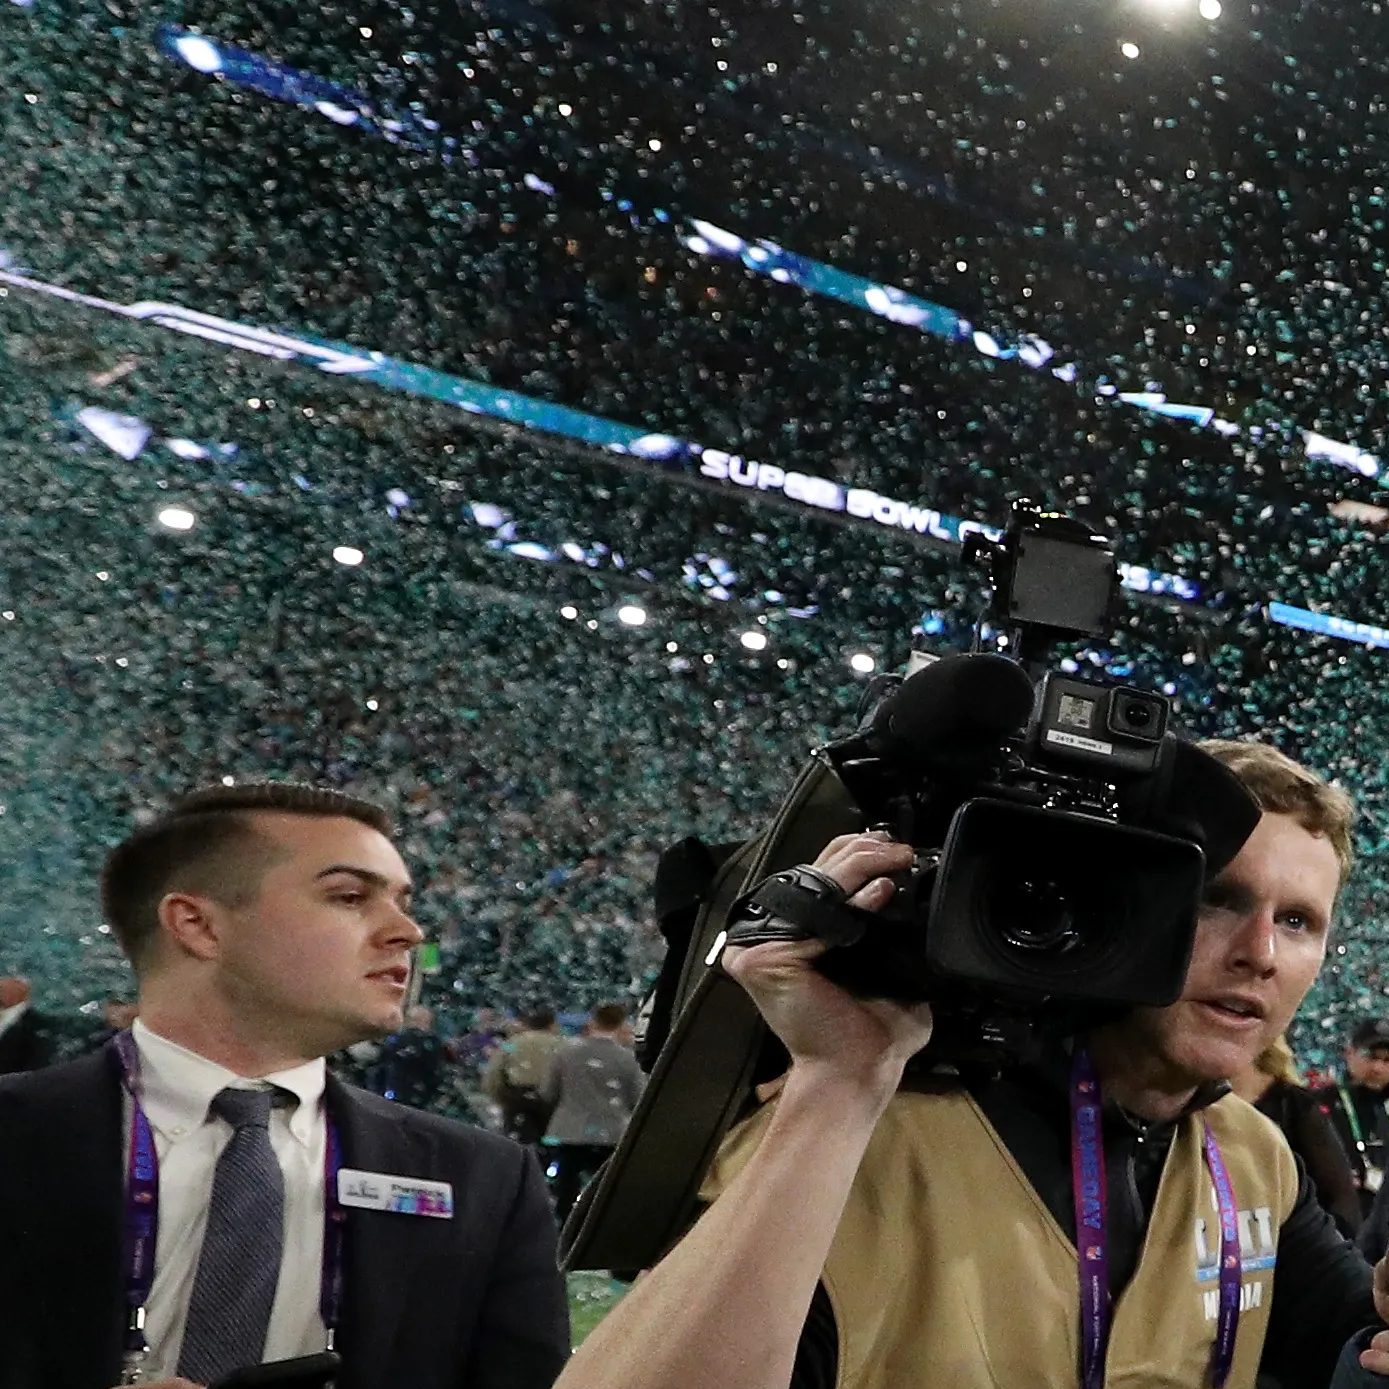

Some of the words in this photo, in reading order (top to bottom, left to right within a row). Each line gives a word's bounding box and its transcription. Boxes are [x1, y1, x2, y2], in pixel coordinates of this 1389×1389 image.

[700, 449, 847, 511] SUPER
[846, 488, 951, 541] BOWL
[1077, 1106, 1101, 1229] GAMEDAY
